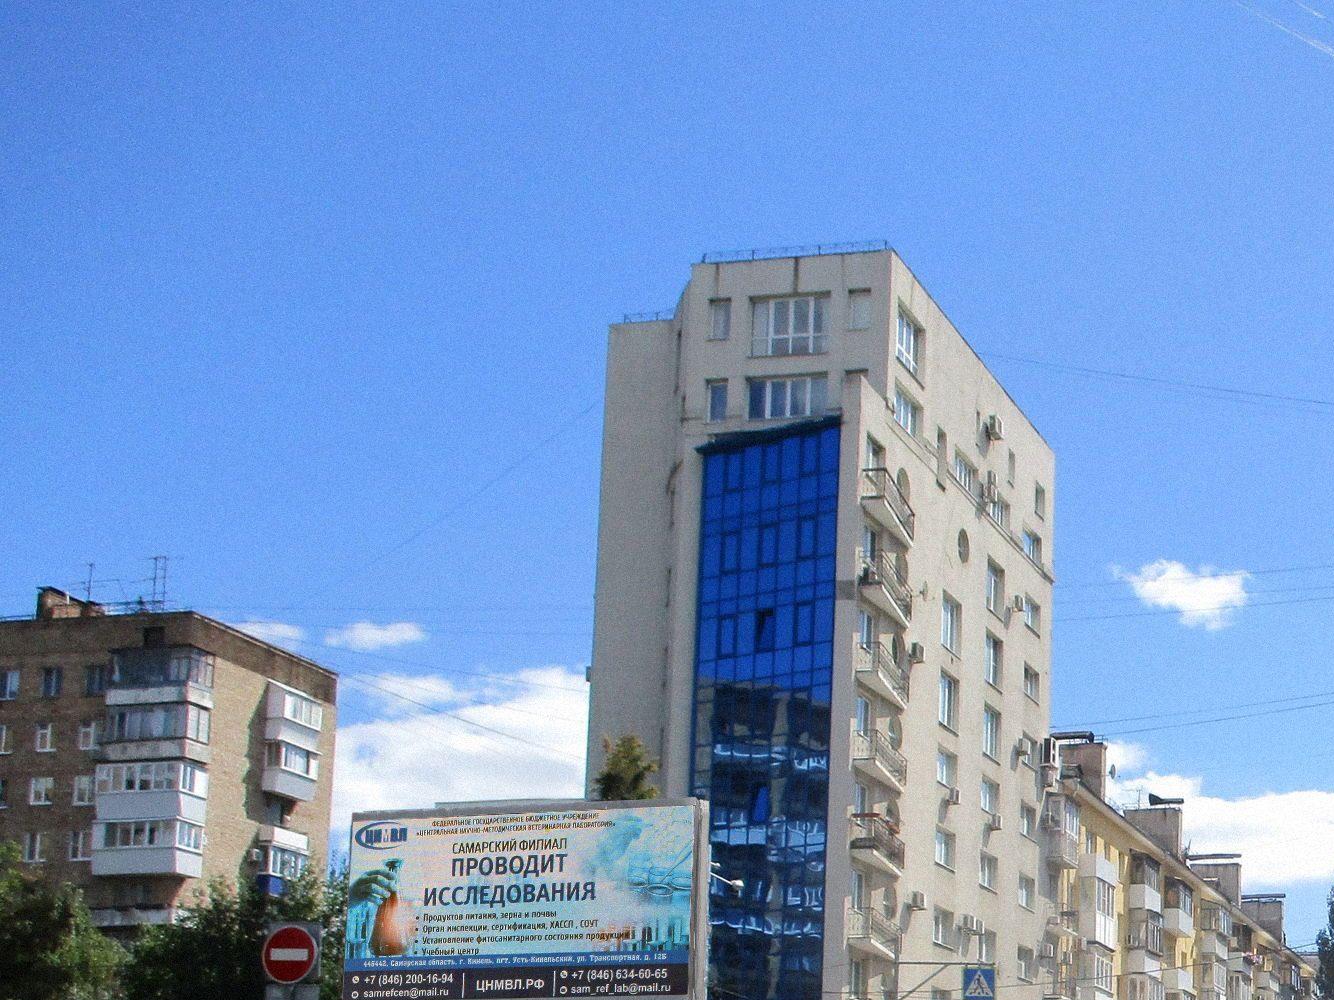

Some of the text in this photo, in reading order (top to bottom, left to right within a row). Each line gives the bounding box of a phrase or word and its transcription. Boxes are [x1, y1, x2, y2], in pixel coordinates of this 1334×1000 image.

[472, 816, 524, 826] ГОСУДАРСТВЕННОЕ
[526, 814, 560, 822] БЮДЖЕТНОЕ
[562, 812, 599, 820] УЧРЕЖДЕНИЕ
[452, 837, 568, 854] САМАРСКИЙ ФИЛИАЛ
[452, 854, 568, 878] ПРОВОДИТ
[424, 882, 596, 908] ИССЛЕДОВАНИЯ
[424, 913, 463, 923] Продуктов
[466, 912, 498, 920] питания,
[500, 912, 522, 920] зерна
[422, 925, 444, 934] Орган
[446, 924, 490, 932] инспекции,
[492, 922, 548, 931] сертификация,
[580, 919, 598, 928] СОУТ
[422, 936, 474, 944] Установление
[476, 934, 542, 944] фитосанитарного
[586, 931, 632, 941] продукции
[422, 948, 480, 956] Учебный центр
[364, 973, 453, 986] +7 (846) 200-16-94
[572, 968, 668, 982] +7 (846) 634-60-65
[476, 978, 544, 993] ЦНМВЛ.РФ
[570, 983, 671, 996] sam_ref_lab@mail.ru
[364, 988, 448, 999] samrefcen@mail.ru
